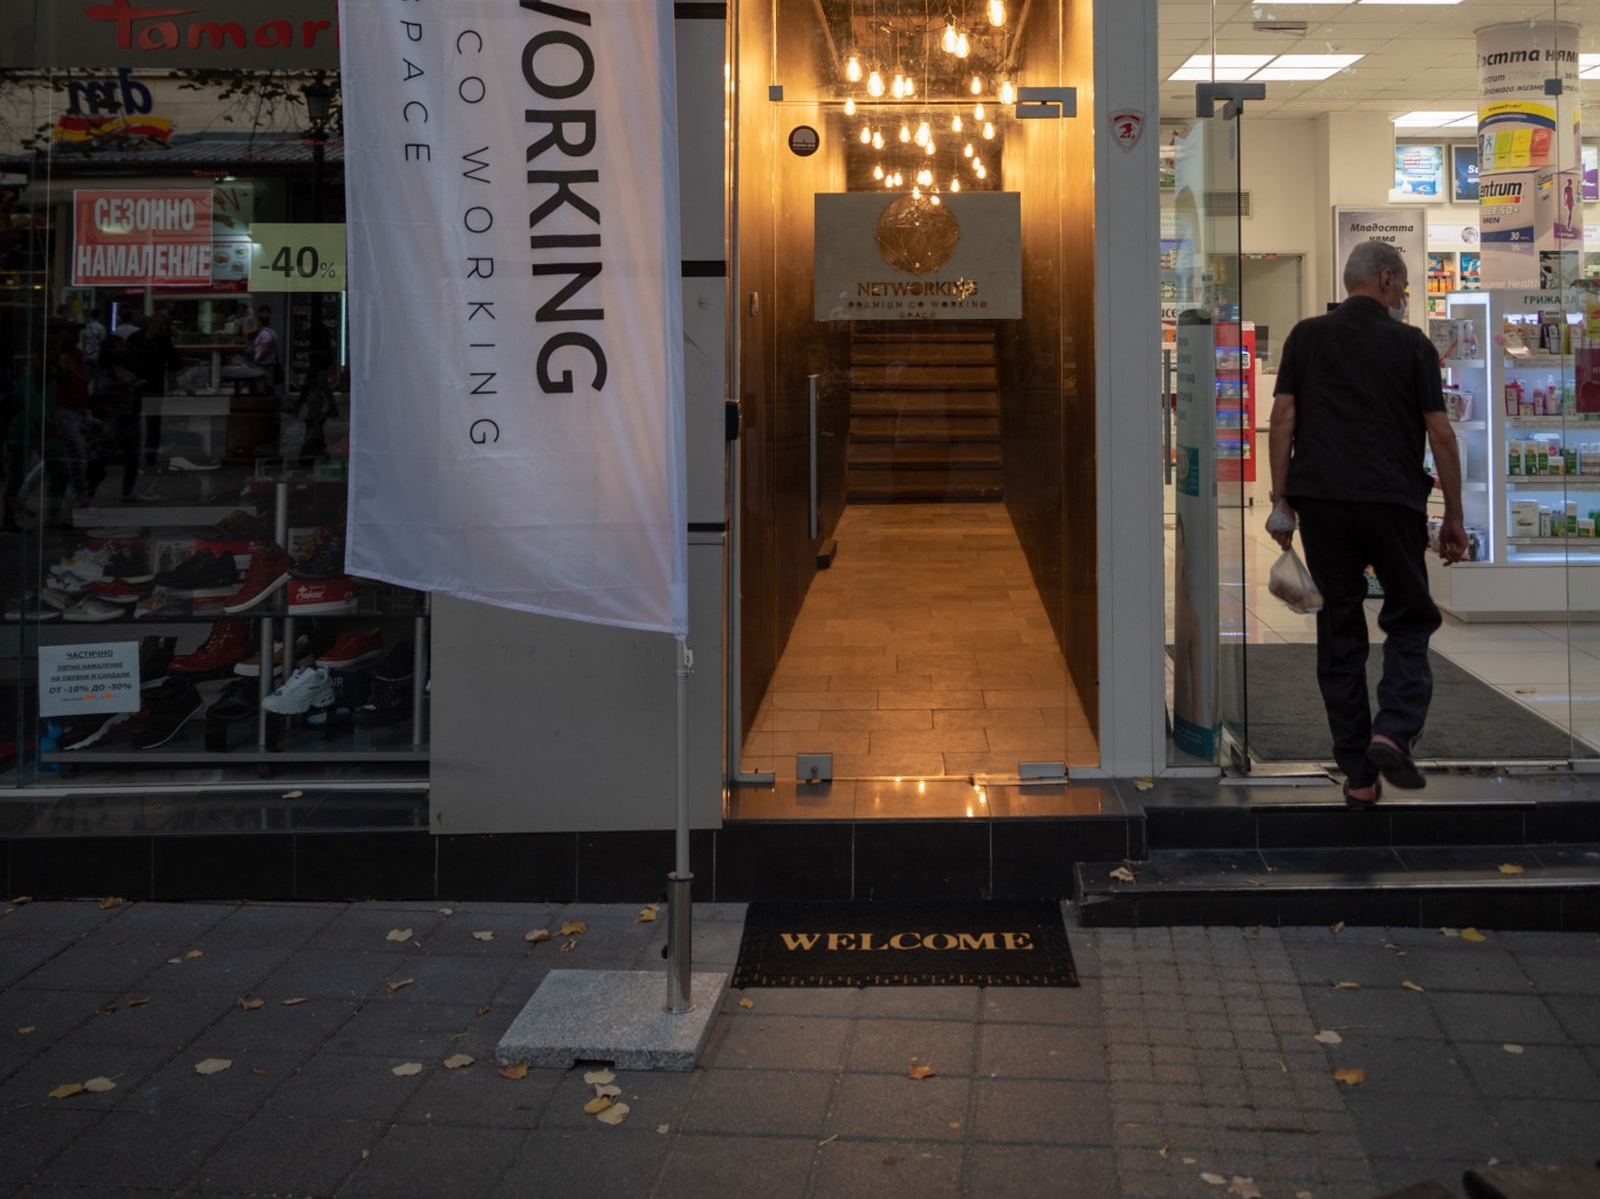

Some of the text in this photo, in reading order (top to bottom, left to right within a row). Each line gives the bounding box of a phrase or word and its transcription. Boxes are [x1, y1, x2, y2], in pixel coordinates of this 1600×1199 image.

[95, 198, 195, 232] СЕЗОННО
[1350, 223, 1414, 233] Младостта
[77, 244, 211, 277] НАМАЛЕНИЕ
[260, 246, 335, 278] -40%
[461, 145, 500, 445] WORKING
[857, 281, 979, 297] NETWORKING
[1524, 295, 1561, 305] ГРИЖА
[66, 650, 113, 660] ЧАСТИЧНО
[779, 931, 1035, 951] WELCOME
